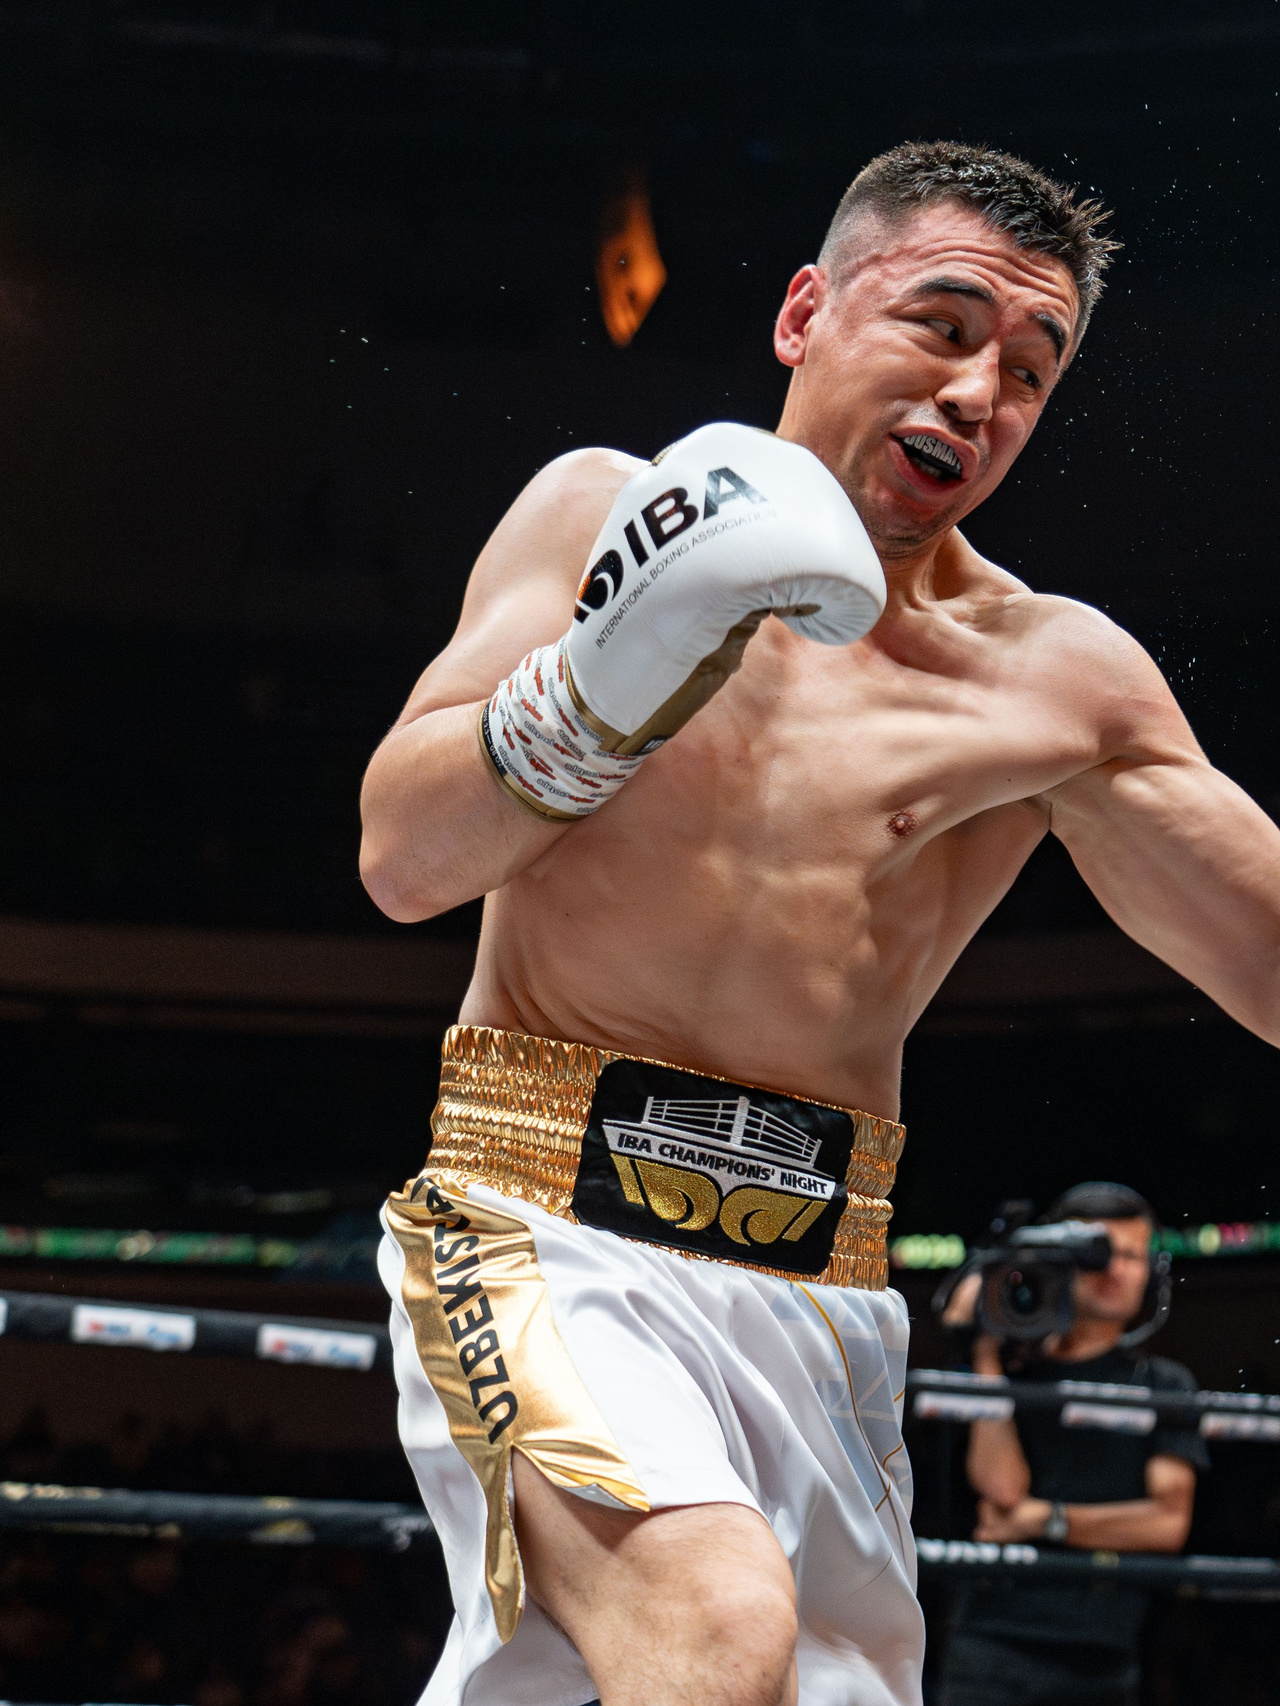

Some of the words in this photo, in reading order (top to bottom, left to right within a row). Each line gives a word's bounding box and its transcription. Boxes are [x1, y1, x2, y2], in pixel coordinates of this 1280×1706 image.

[623, 466, 769, 569] IBA
[595, 577, 652, 650] INTERNATIONAL
[650, 542, 690, 581] BOXING
[692, 508, 779, 548] ASSOCIATION
[617, 1132, 653, 1155] IBA
[658, 1142, 776, 1182] CHAMPIONS'
[779, 1171, 828, 1196] NIGHT
